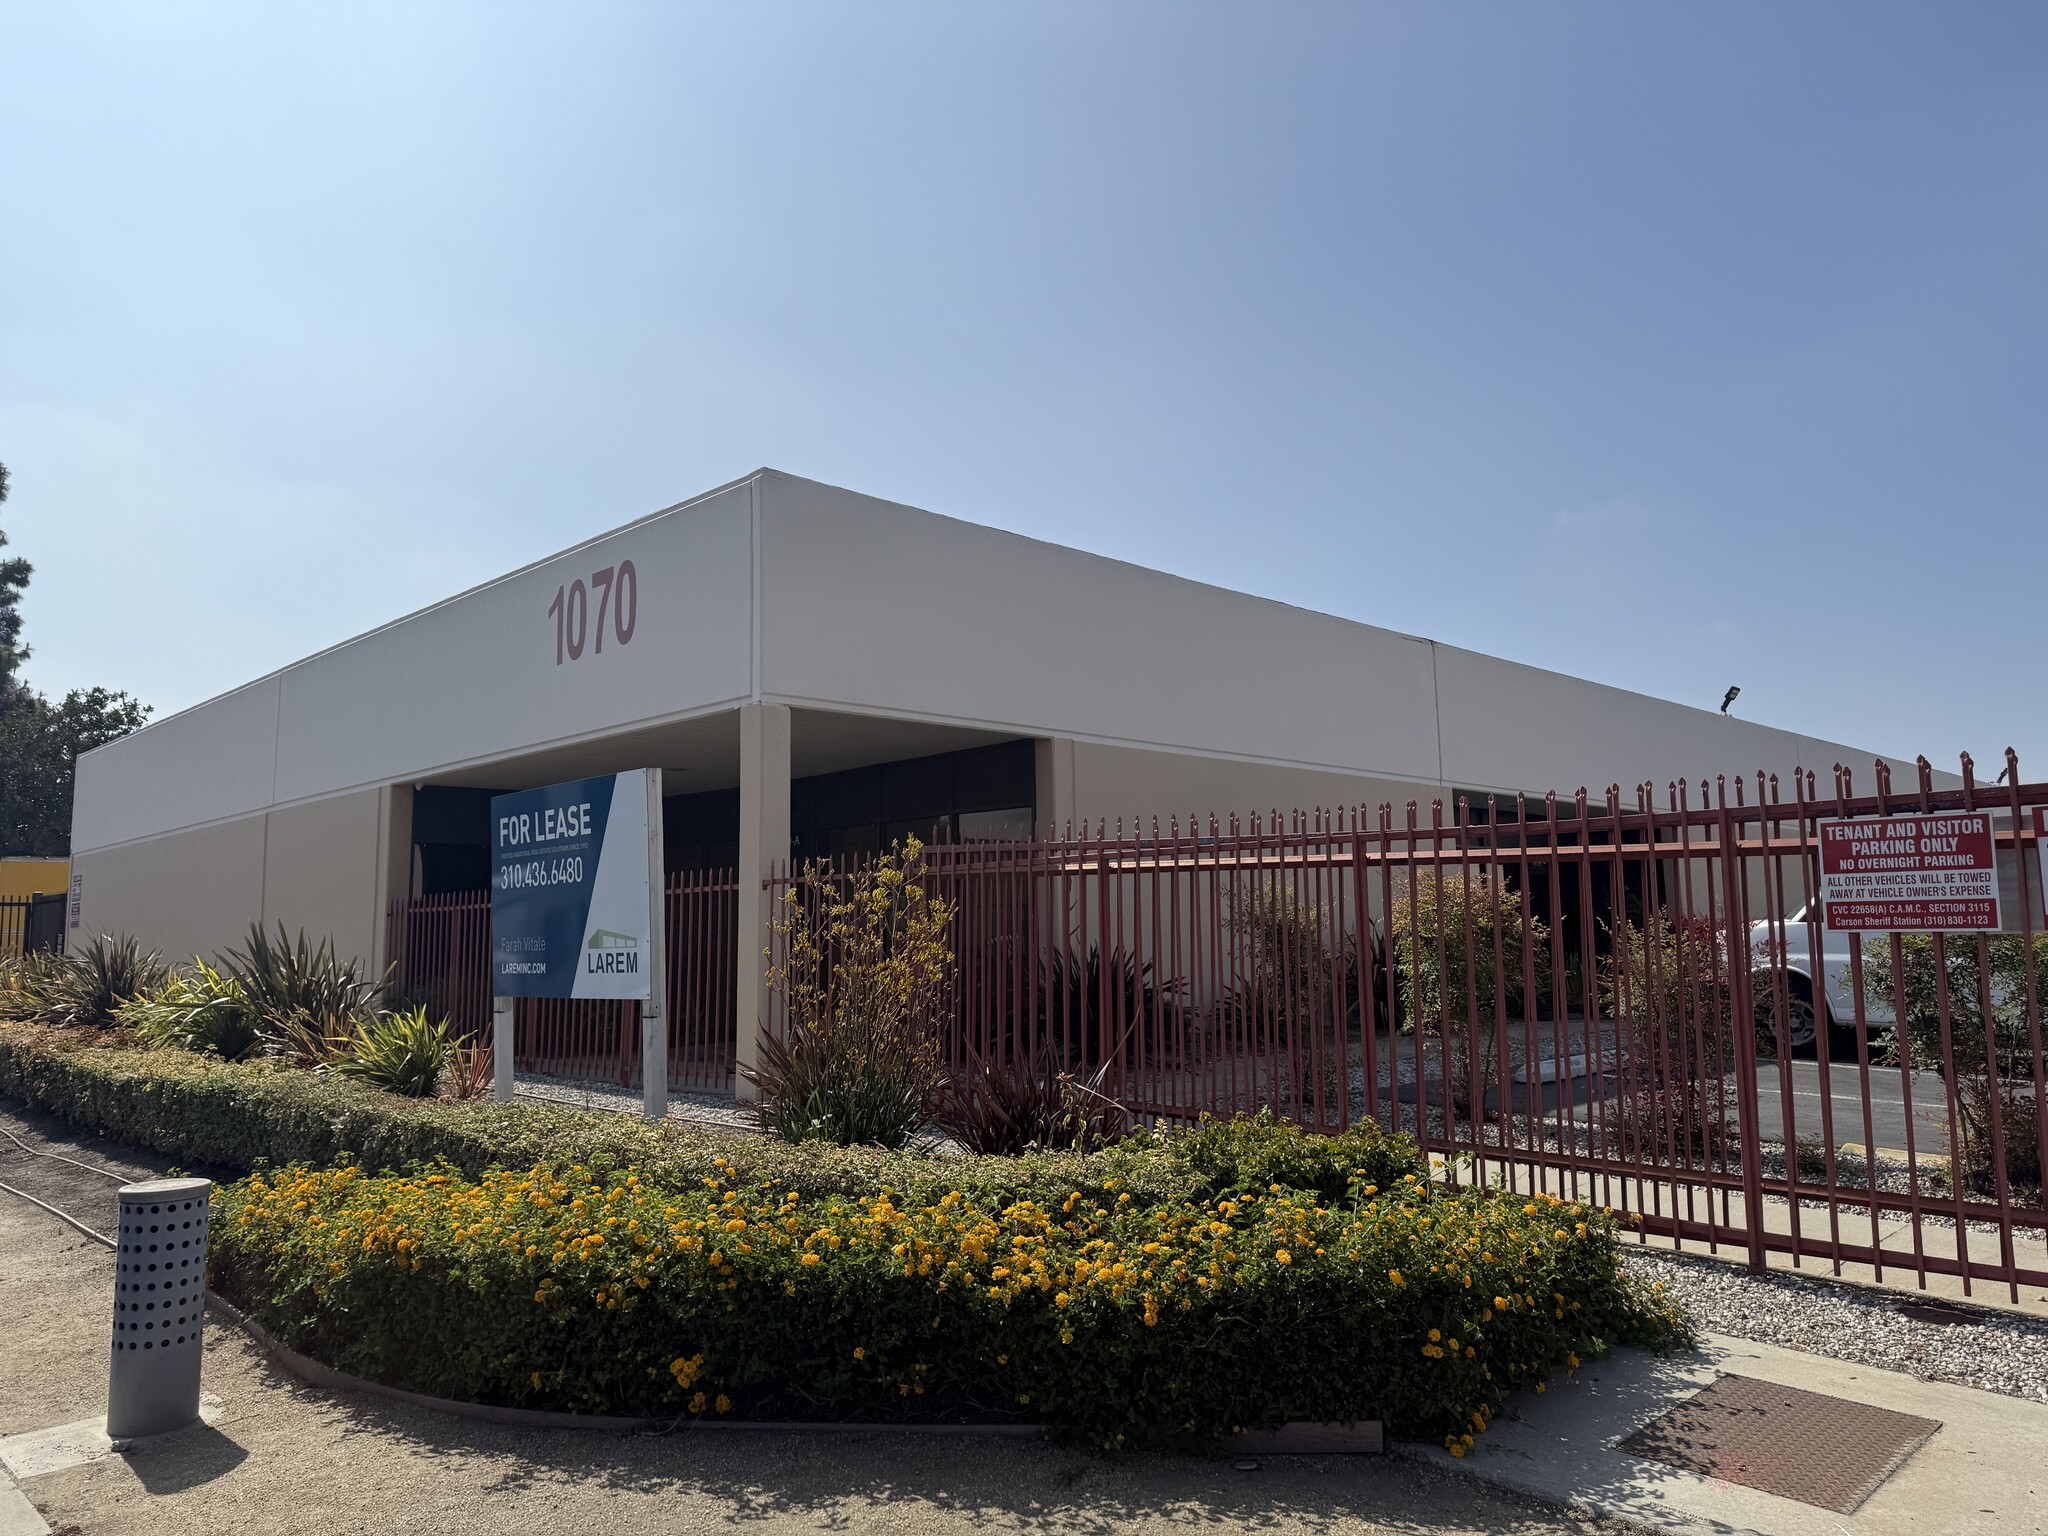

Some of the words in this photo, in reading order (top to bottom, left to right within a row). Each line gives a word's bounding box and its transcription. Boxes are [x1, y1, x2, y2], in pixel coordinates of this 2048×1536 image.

[548, 559, 637, 666] 1070
[500, 813, 531, 847] FOR
[535, 803, 592, 843] LEASE
[1826, 824, 1882, 840] TENANT
[1886, 822, 1917, 838] AND
[1920, 818, 1984, 836] VISITOR
[1851, 839, 1916, 856] PARKING
[1920, 837, 1959, 853] ONLY
[1840, 858, 1855, 870] NO
[1858, 856, 1921, 870] OVERNIGHT
[1924, 854, 1974, 867] PARKING
[500, 856, 583, 890] 310.436.6480
[1827, 877, 1843, 887] ALL
[1845, 876, 1873, 887] OTHER
[1874, 874, 1917, 886] VEHICLES
[1919, 873, 1942, 885] WILL
[1944, 873, 1956, 884] BE
[1958, 872, 1991, 883] TOWED
[1830, 888, 1853, 899] AWAY
[1855, 888, 1865, 899] AT
[1867, 887, 1904, 899] VEHICLE
[1906, 886, 1947, 897] OWNER'S
[1949, 885, 1991, 896] EXPENSE
[1832, 905, 1849, 915] CVC
[1850, 904, 1887, 916] 22658(A)
[1889, 904, 1927, 914] C.A.M.C.,
[1928, 903, 1966, 912] SECTION
[1968, 902, 1990, 912] 3115
[1835, 917, 1863, 927] Carson
[1864, 916, 1891, 926] Sheriff
[1893, 916, 1922, 926] Station
[1924, 915, 1946, 927] (310)
[1947, 915, 1988, 925] 830-1123
[501, 937, 521, 952] Farah
[523, 936, 546, 952] Vitale
[501, 962, 546, 974] LAREMINC.COM
[587, 952, 638, 974] LAREM
